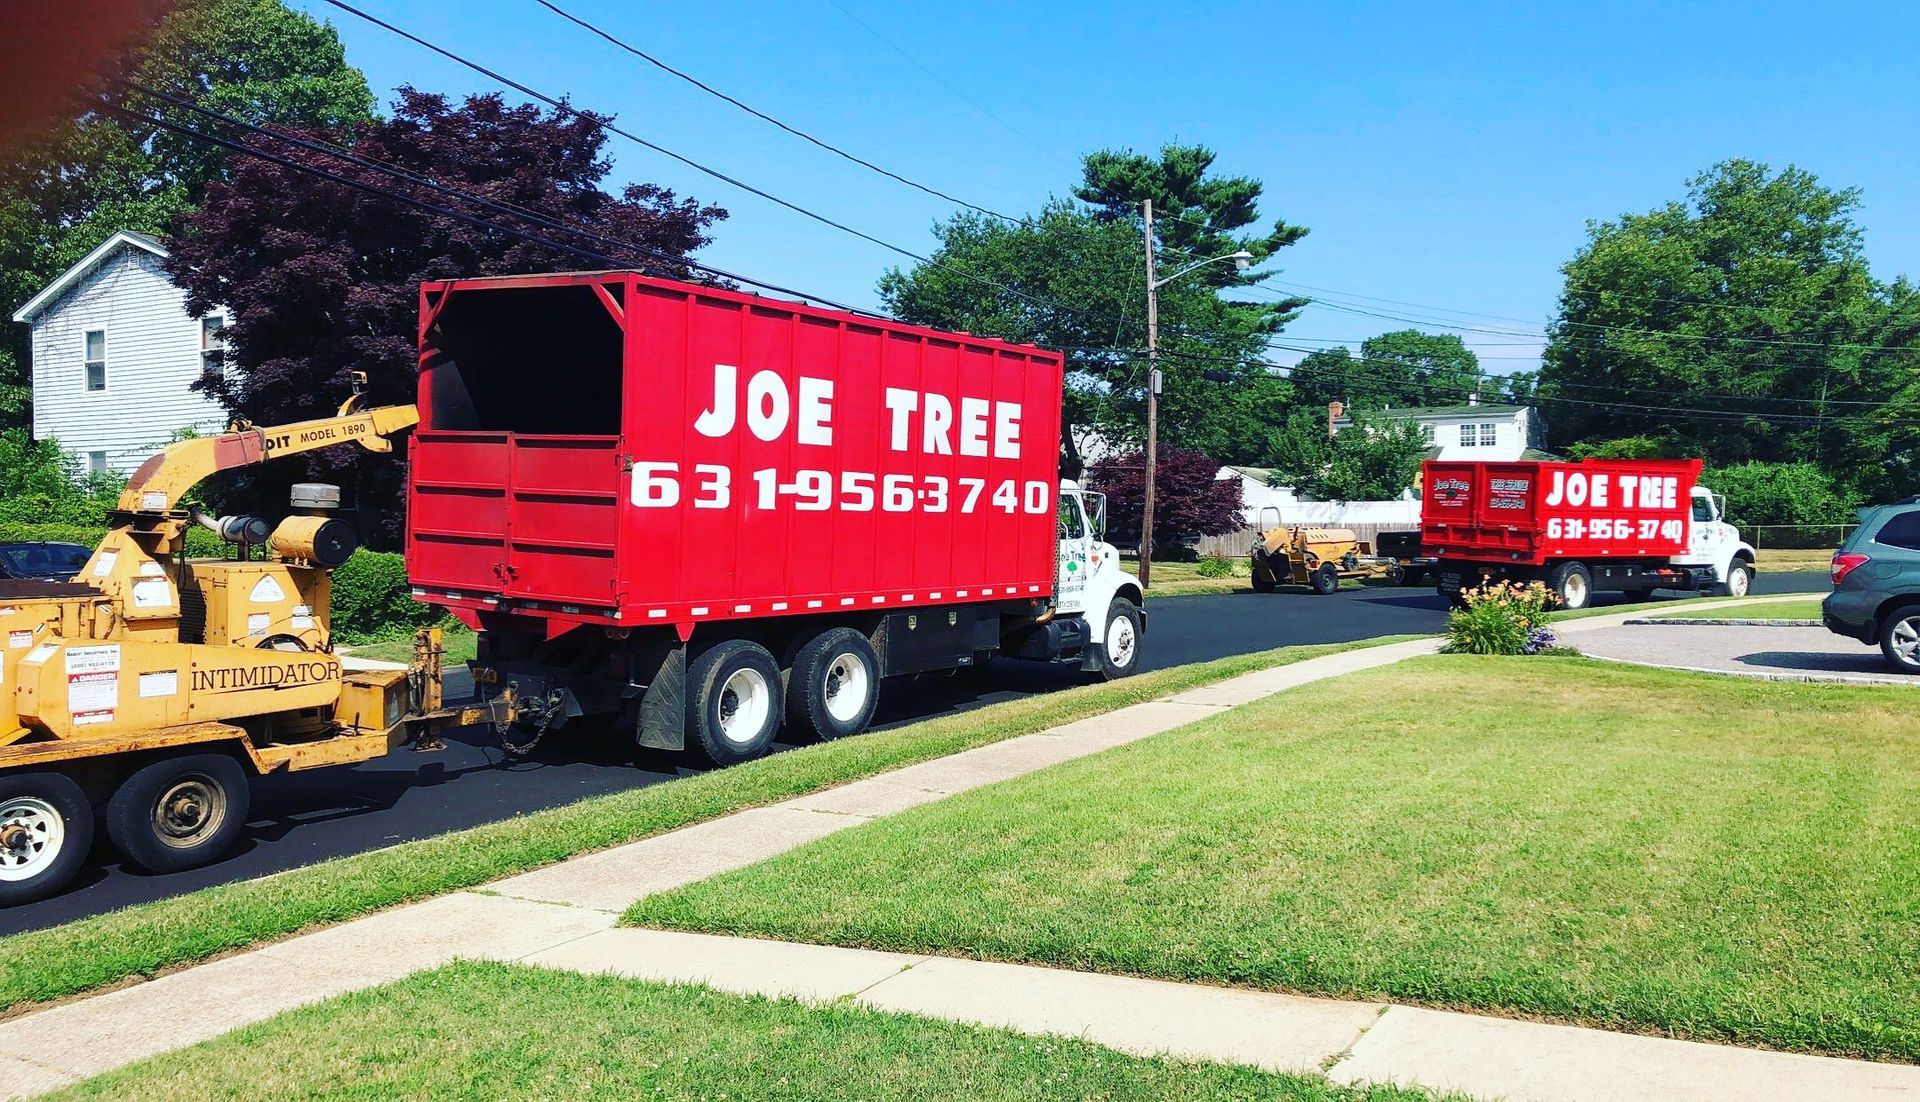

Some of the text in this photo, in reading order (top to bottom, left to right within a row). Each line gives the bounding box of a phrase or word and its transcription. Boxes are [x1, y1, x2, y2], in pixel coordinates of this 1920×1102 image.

[693, 364, 1022, 459] JOE TREE
[264, 424, 366, 450] DIT MODEL 1890
[1434, 478, 1470, 491] Joe Tree
[1545, 471, 1678, 508] JOE TREE
[79, 673, 116, 682] DANGER!
[191, 662, 340, 690] INTIMIDATOR
